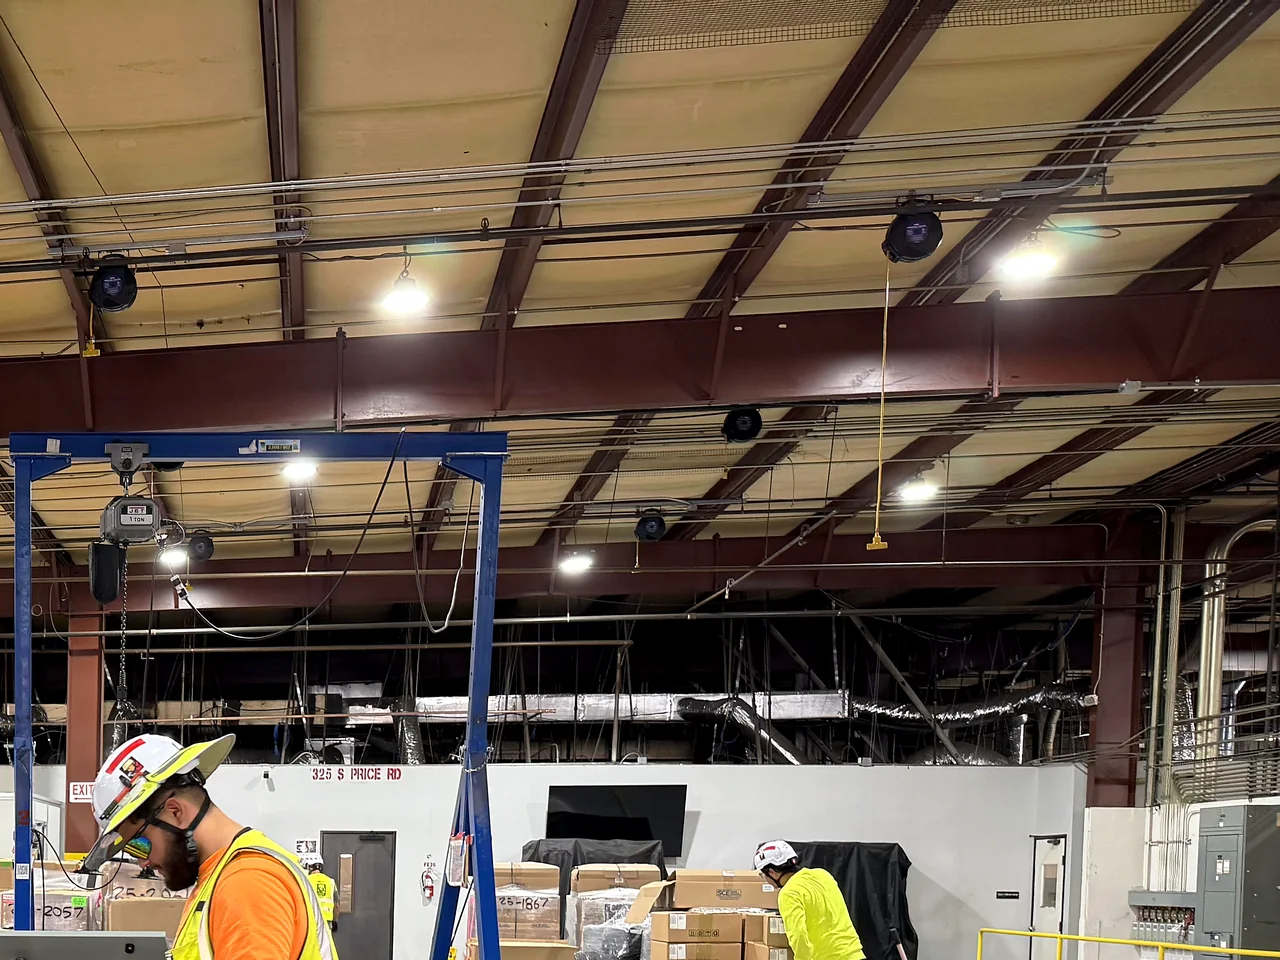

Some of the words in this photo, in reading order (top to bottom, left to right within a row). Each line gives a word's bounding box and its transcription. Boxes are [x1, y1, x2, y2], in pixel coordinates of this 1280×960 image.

[337, 767, 345, 780] S
[350, 767, 381, 780] PRICE
[386, 767, 402, 780] RD
[72, 784, 94, 796] EXIT
[498, 896, 549, 911] 25-1867
